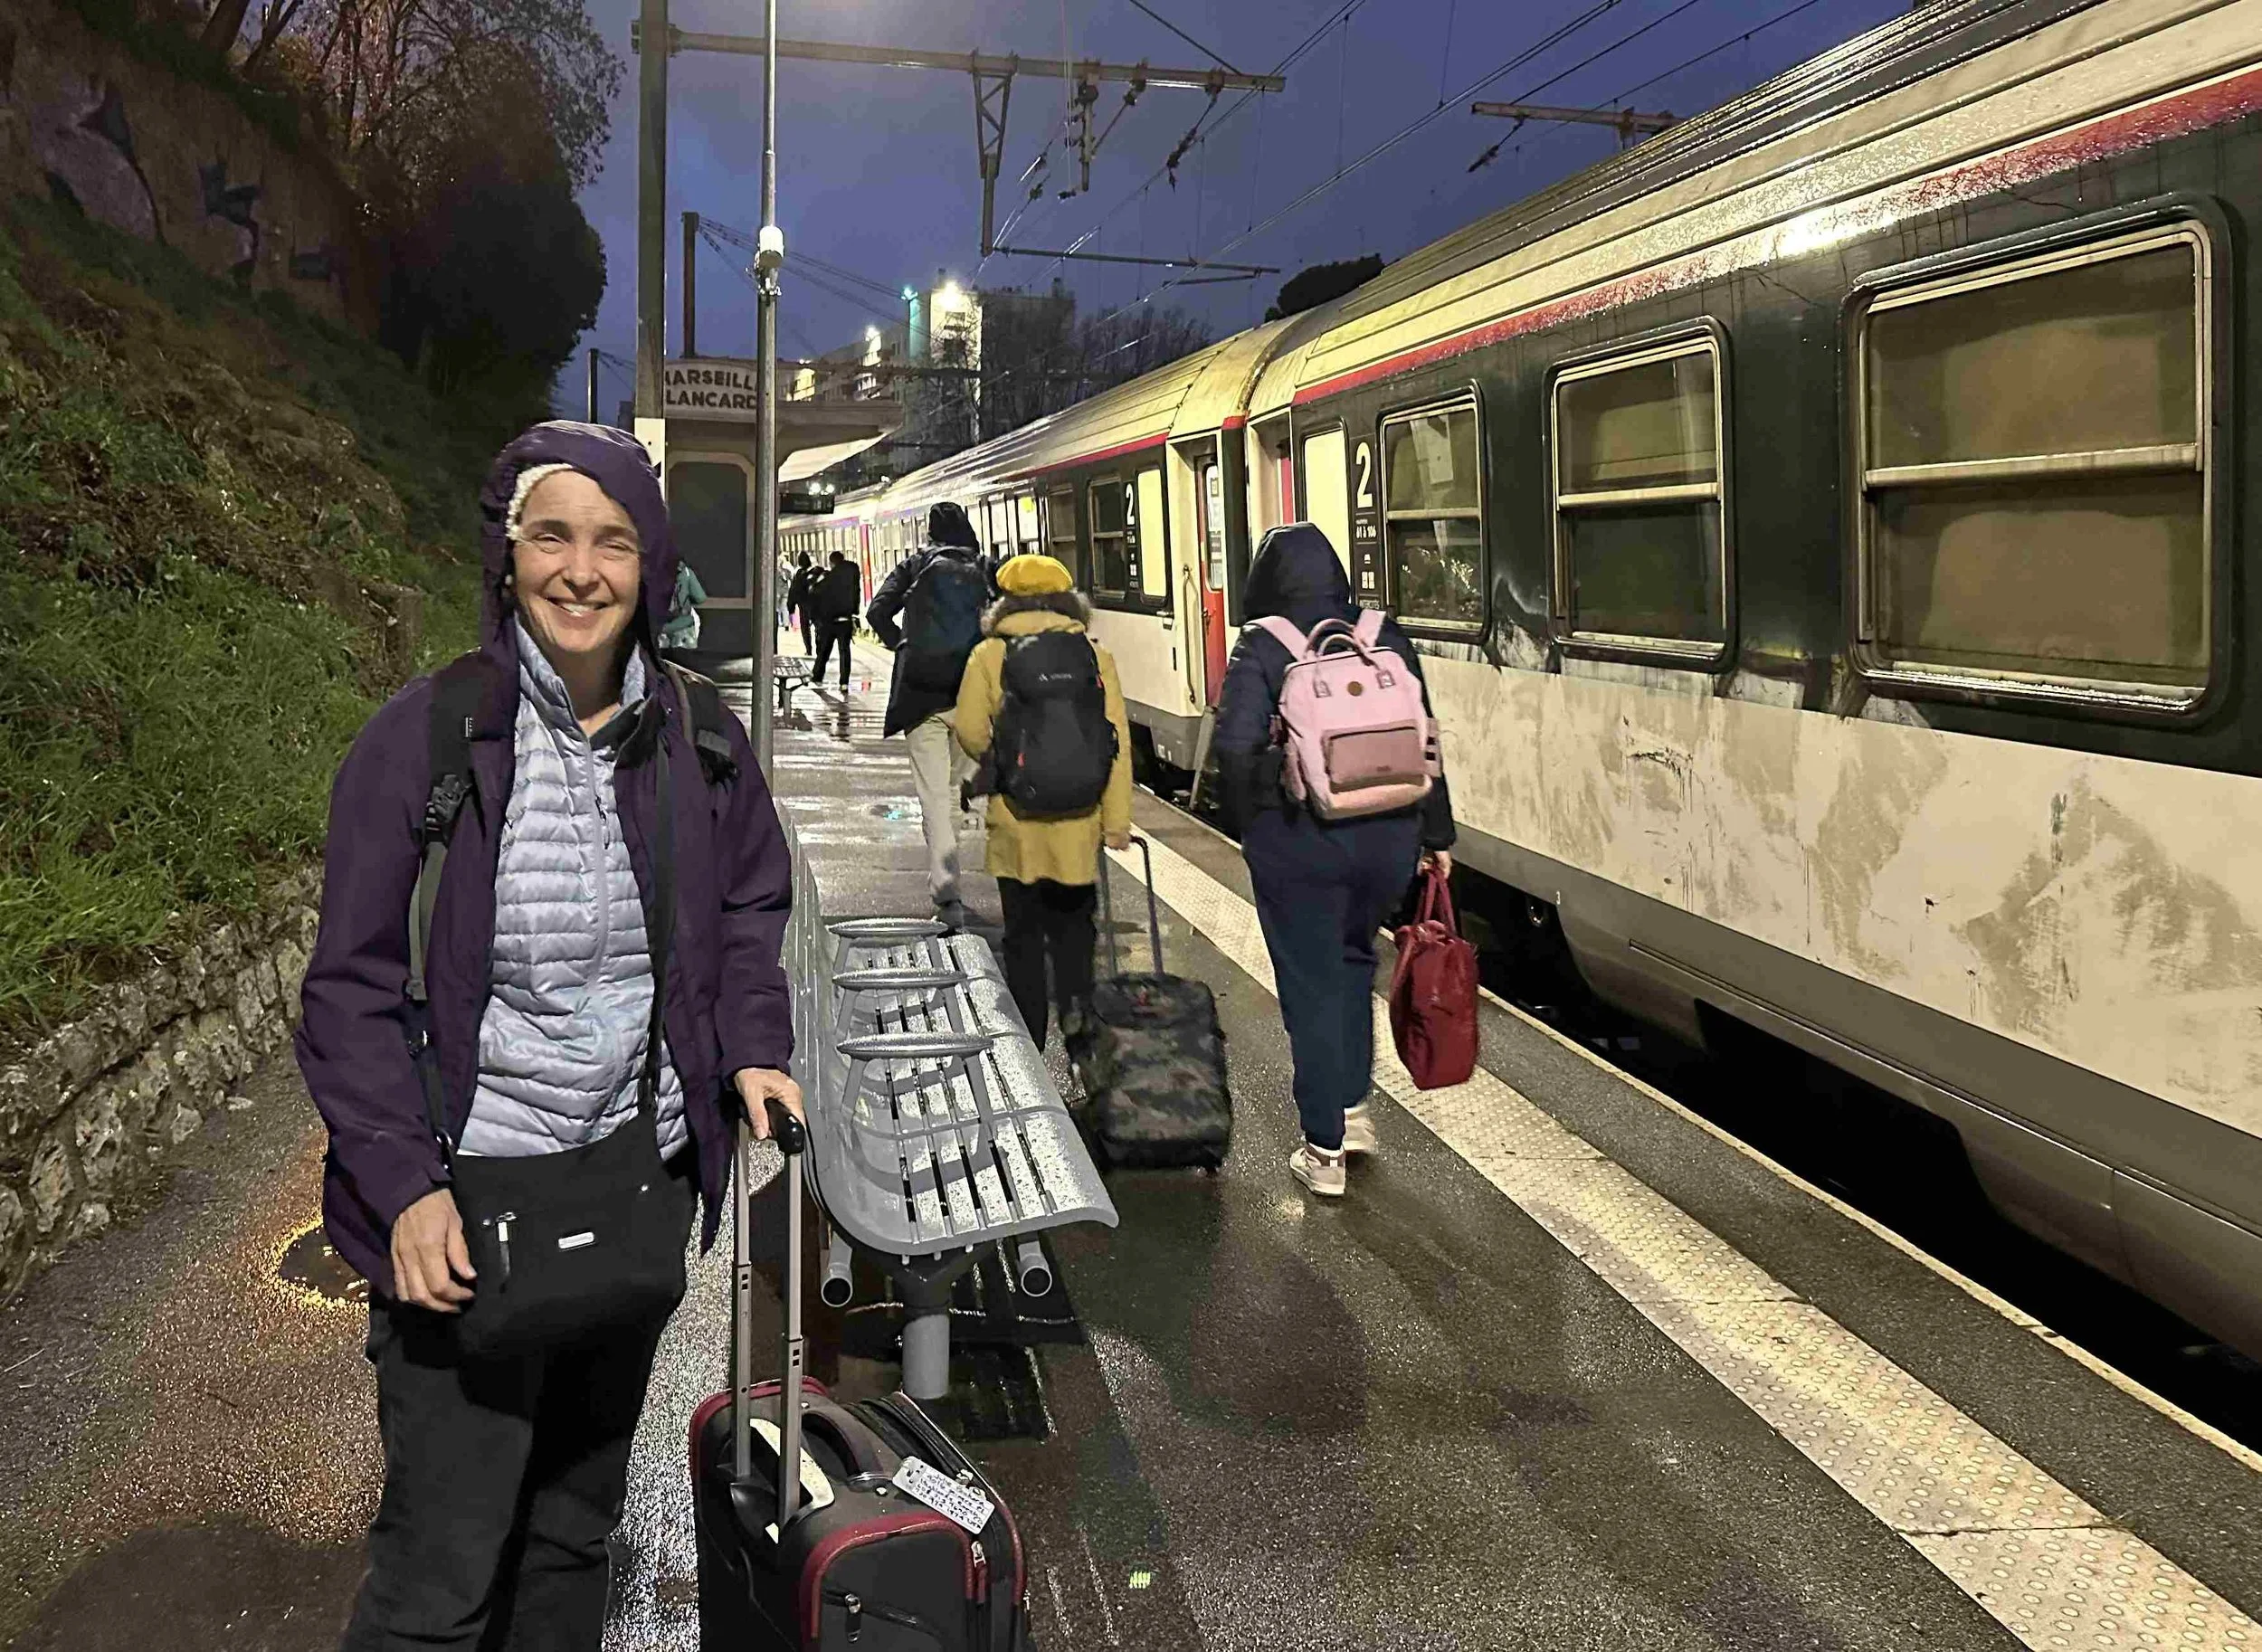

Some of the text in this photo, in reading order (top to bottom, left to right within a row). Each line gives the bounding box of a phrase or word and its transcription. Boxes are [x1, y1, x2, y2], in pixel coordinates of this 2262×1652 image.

[666, 369, 757, 391] ARSEILL
[666, 390, 757, 410] LANCARD
[1355, 441, 1373, 508] 2
[1126, 483, 1136, 525] 2
